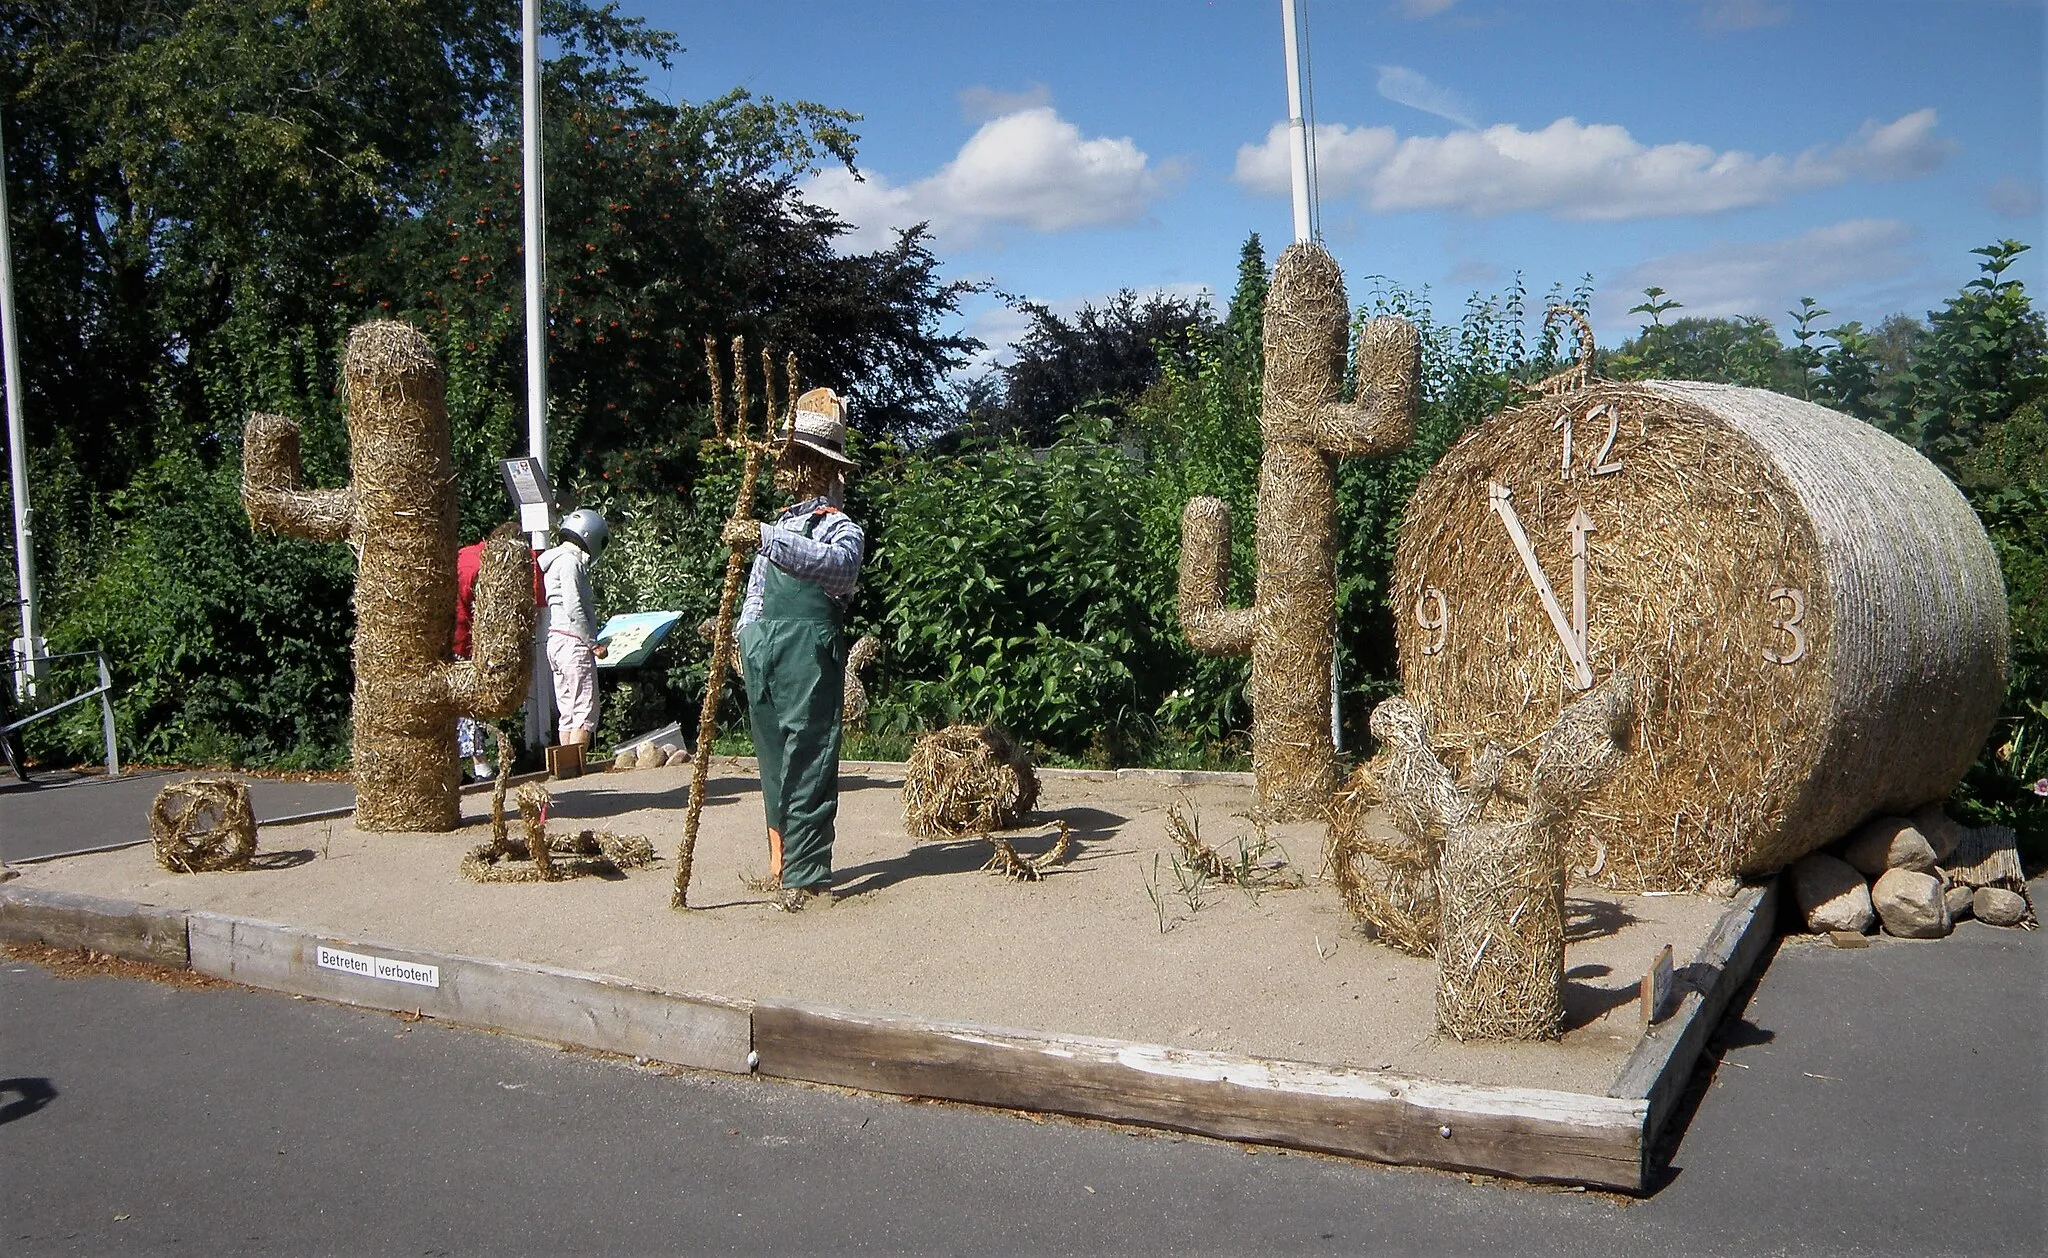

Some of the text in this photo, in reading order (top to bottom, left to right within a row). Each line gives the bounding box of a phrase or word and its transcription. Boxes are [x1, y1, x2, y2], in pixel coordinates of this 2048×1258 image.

[1553, 402, 1623, 480] 12
[1416, 588, 1447, 655] 9
[1762, 588, 1805, 664] 3
[322, 951, 433, 983] Betreten verboten!
